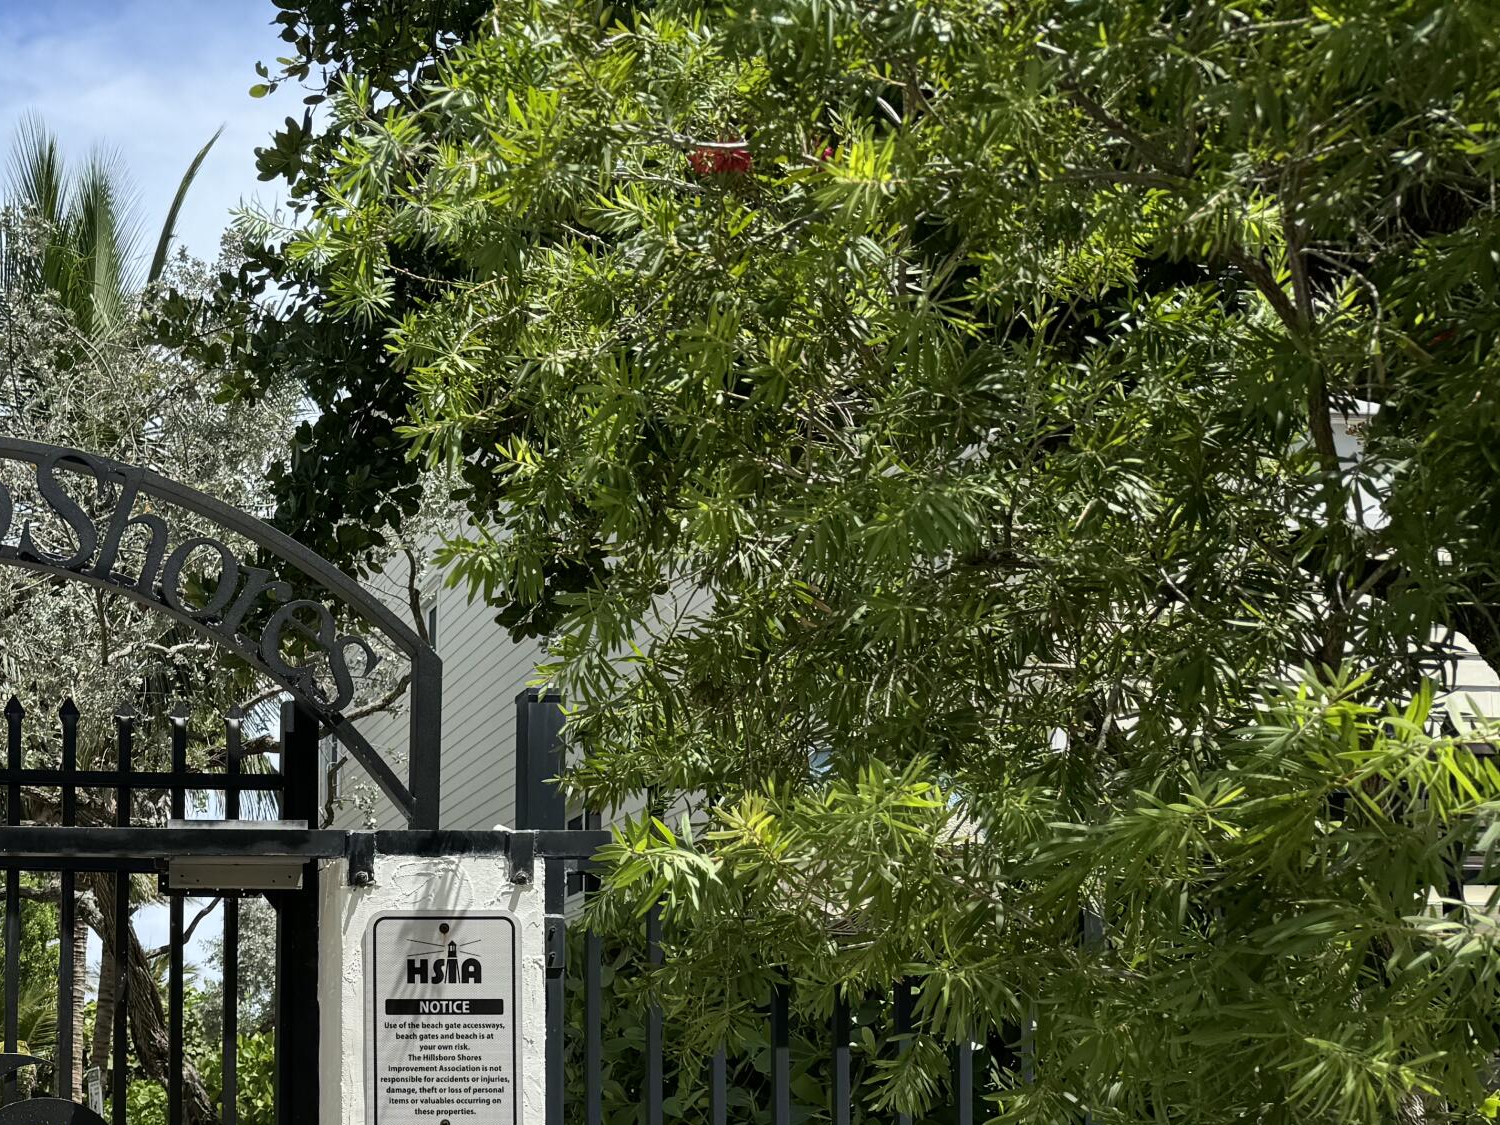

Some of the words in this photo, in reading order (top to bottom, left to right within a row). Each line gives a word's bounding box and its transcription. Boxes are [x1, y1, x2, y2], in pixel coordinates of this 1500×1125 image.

[19, 450, 381, 713] Shores
[407, 958, 482, 984] HSIA
[419, 1001, 470, 1013] NOTICE
[445, 1023, 461, 1031] gate
[463, 1023, 505, 1031] accessways,
[419, 1034, 439, 1042] gates
[388, 1065, 437, 1074] Improvement
[380, 1076, 422, 1085] responsible
[480, 1076, 510, 1085] injuries,
[386, 1087, 417, 1095] damage,
[473, 1087, 504, 1096] personal
[456, 1098, 490, 1107] occurring
[436, 1108, 476, 1117] properties.
